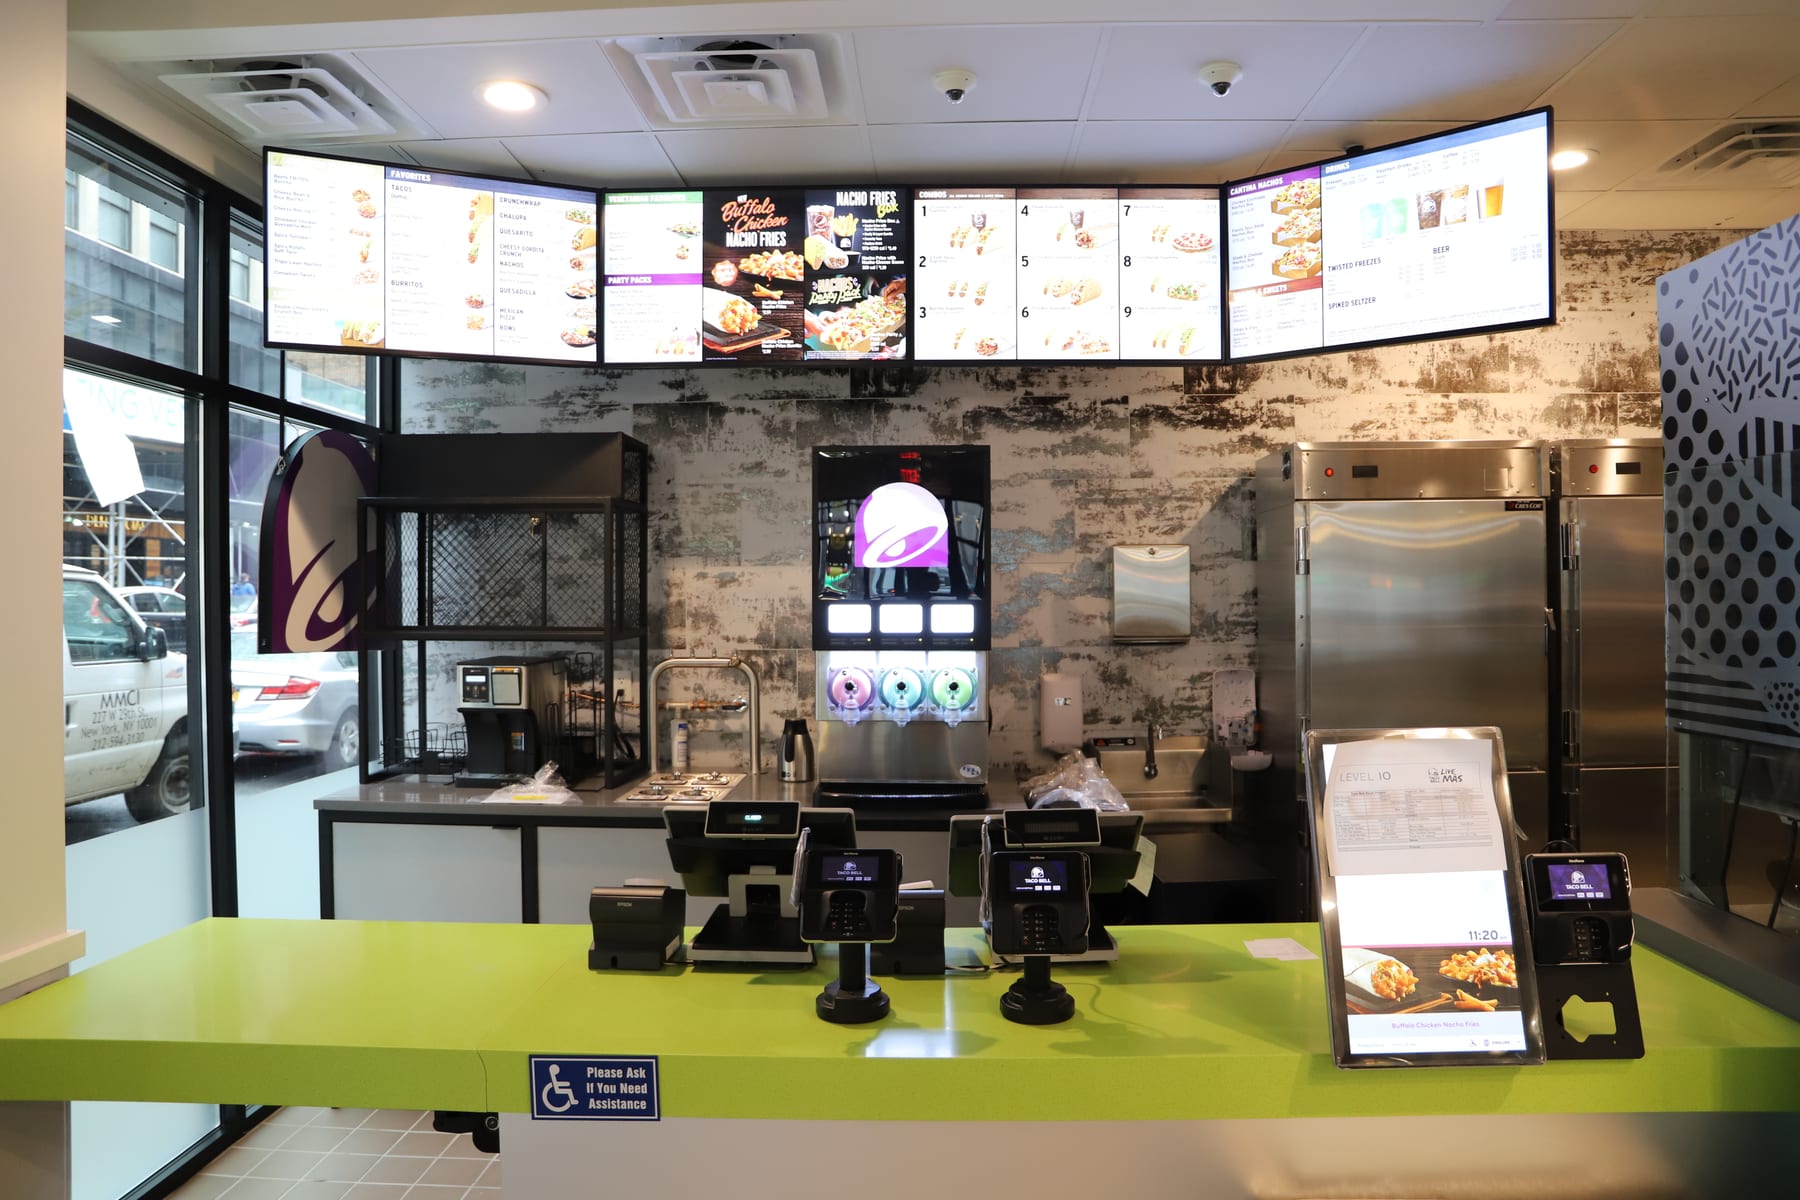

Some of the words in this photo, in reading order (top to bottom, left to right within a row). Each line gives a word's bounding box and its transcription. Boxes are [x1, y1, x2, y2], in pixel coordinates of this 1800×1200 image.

[390, 170, 431, 182] FAVORITES
[391, 184, 413, 192] TACOS
[1230, 184, 1257, 196] CANTINA
[1258, 178, 1283, 190] NACHOS
[836, 191, 867, 206] NACHO
[869, 191, 897, 206] FRIES
[919, 191, 947, 199] COMBOS
[499, 197, 542, 207] CRUNCHWRAP
[721, 197, 776, 222] Buffalo
[921, 204, 927, 216] 1
[1021, 204, 1029, 216] 4
[1123, 204, 1131, 216] 7
[499, 212, 527, 221] CHALUPA
[734, 213, 790, 233] Chicken
[726, 232, 758, 248] NACHO
[760, 231, 787, 247] FRIES
[1433, 245, 1450, 255] BEER
[499, 260, 524, 269] NACHOS
[919, 256, 927, 268] 2
[1021, 256, 1029, 267] 5
[1123, 256, 1132, 268] 8
[1328, 262, 1354, 272] TWISTED
[1354, 257, 1382, 267] FREEZES
[391, 279, 424, 288] BURRITOS
[630, 276, 652, 284] PACKS
[499, 287, 537, 296] QUESADILLA
[1328, 300, 1350, 310] SPIKED
[1350, 296, 1377, 307] SELTZER
[919, 306, 927, 318] 3
[1021, 306, 1029, 318] 6
[1124, 306, 1132, 318] 9
[100, 688, 140, 709] MMCI
[92, 710, 107, 724] 227
[108, 709, 116, 720] W
[81, 728, 98, 739] New
[124, 720, 134, 731] NY
[137, 717, 158, 730] 10001
[1340, 772, 1375, 782] LEVEL
[1378, 771, 1392, 781] 10
[1469, 930, 1498, 941] 11:20
[1465, 1020, 1480, 1028] Fries
[587, 1067, 623, 1079] Please
[626, 1067, 647, 1079] Ask
[587, 1083, 595, 1094] If
[597, 1083, 617, 1094] You
[620, 1083, 647, 1094] Need
[589, 1098, 647, 1110] Assistance
